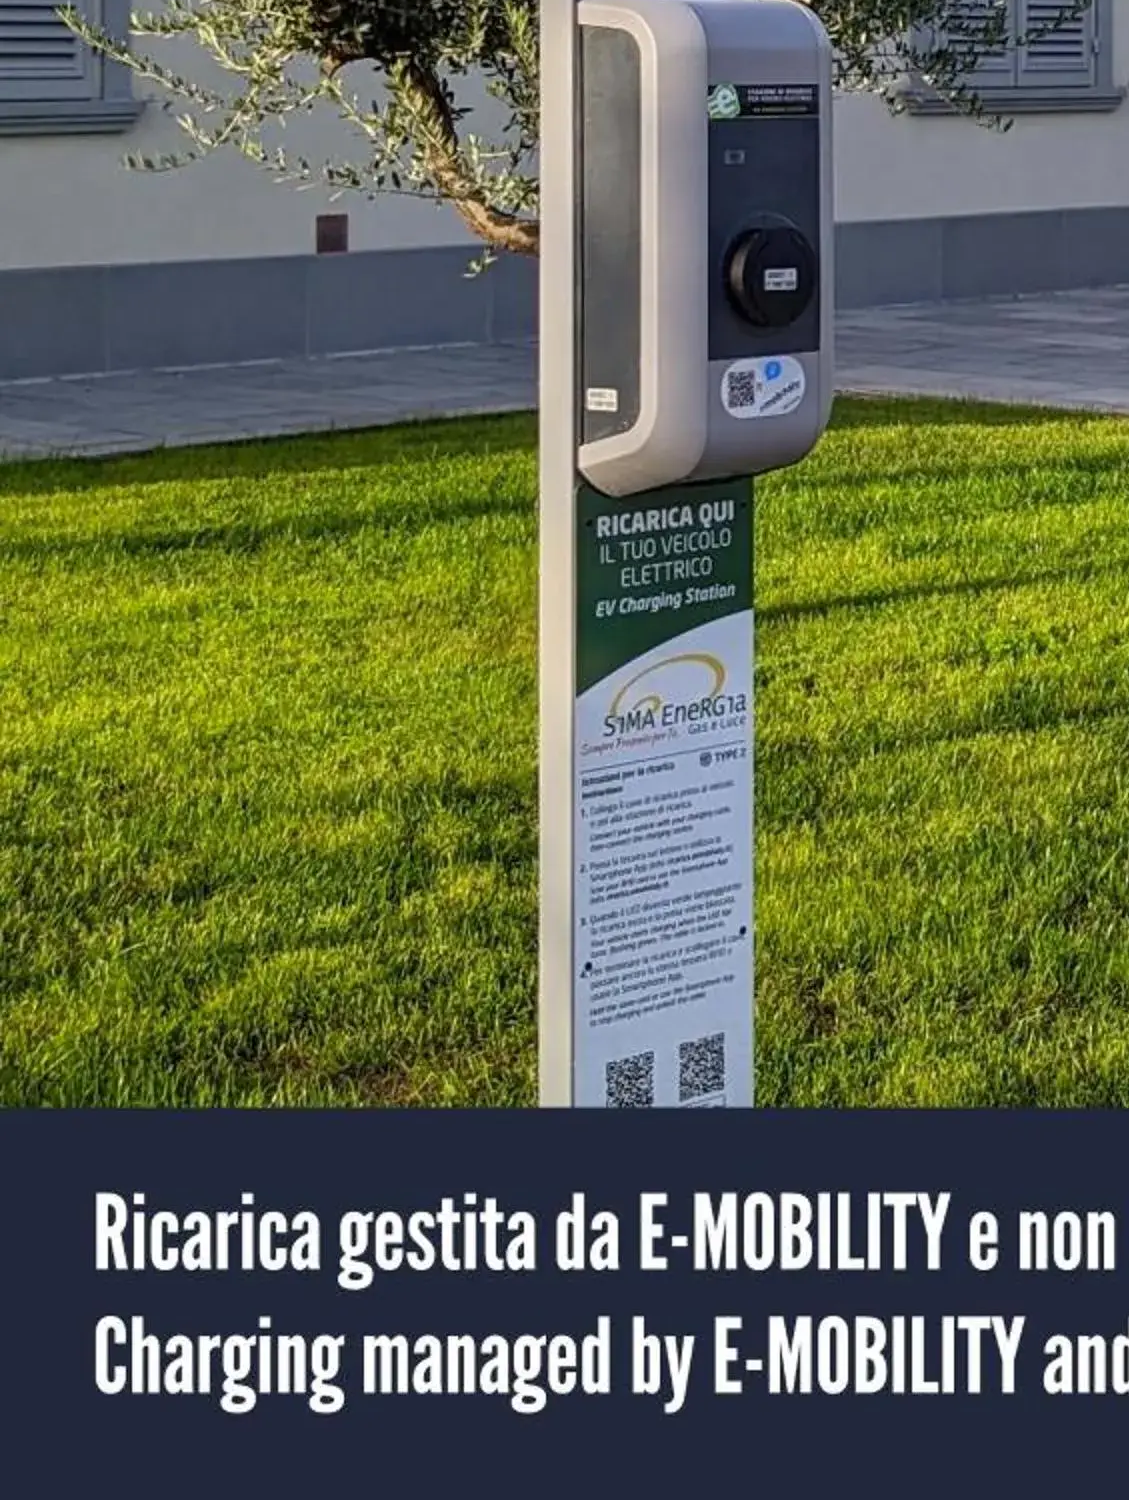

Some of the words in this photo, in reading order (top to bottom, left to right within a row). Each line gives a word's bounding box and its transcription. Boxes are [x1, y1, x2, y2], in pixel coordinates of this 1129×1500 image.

[596, 506, 694, 538] RICARICA
[698, 500, 735, 529] QUI
[599, 544, 616, 564] IL
[620, 538, 657, 562] TUO
[660, 528, 733, 556] VEICOLO
[620, 555, 714, 588] ELETTRICO
[595, 599, 617, 618] EV
[619, 590, 682, 615] Charging
[684, 583, 737, 604] Station
[715, 748, 740, 763] TYPE
